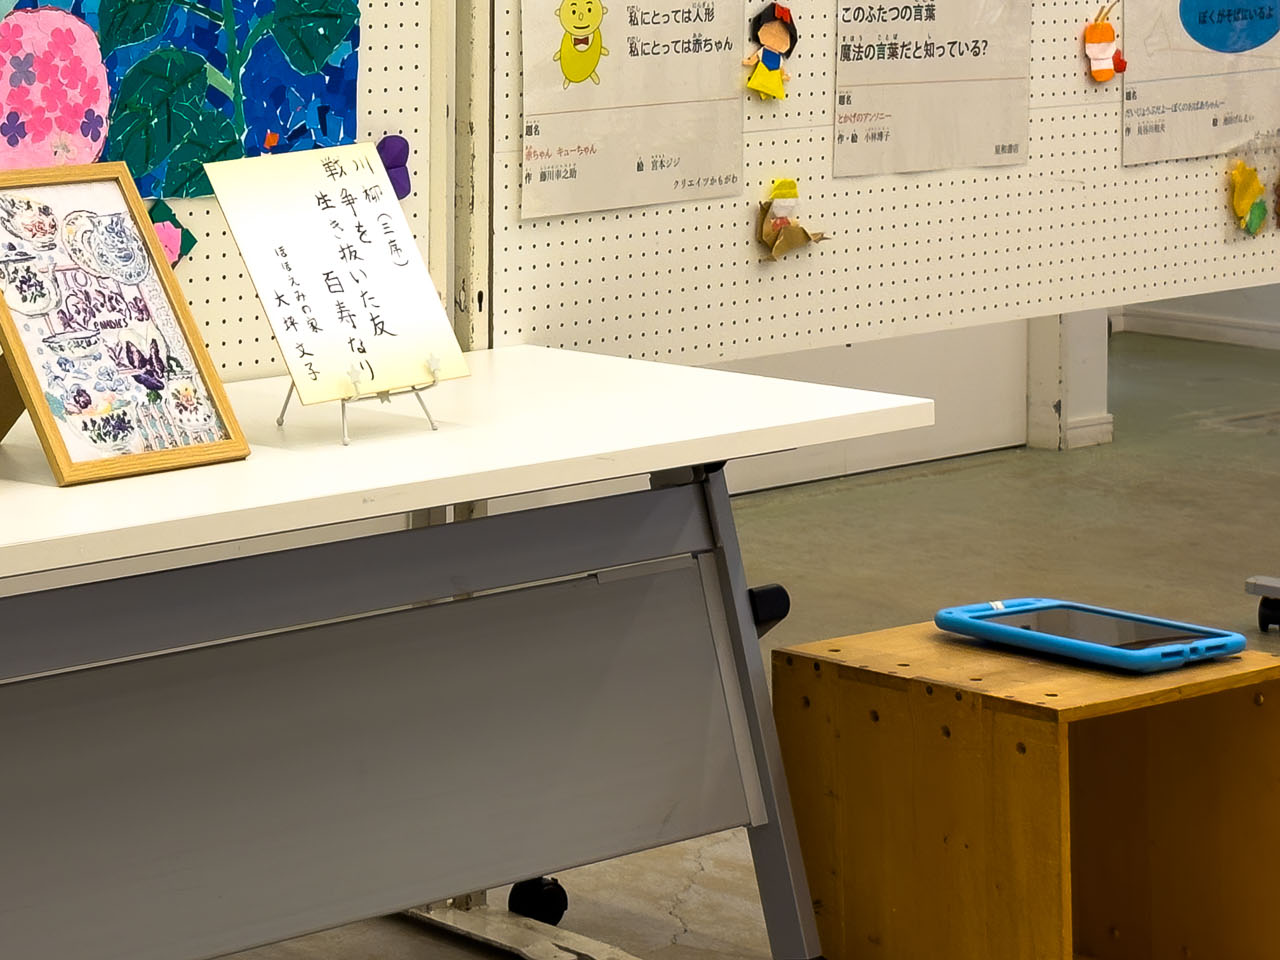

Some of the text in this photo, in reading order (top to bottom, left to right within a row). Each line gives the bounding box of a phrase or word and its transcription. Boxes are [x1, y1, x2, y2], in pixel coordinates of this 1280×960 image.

[627, 7, 716, 27] 私にとっては人形
[841, 3, 937, 24] このふたつの言葉
[627, 36, 734, 58] 私にとっては赤ちゃん
[839, 38, 989, 63] 魔法の言葉だと知っている?
